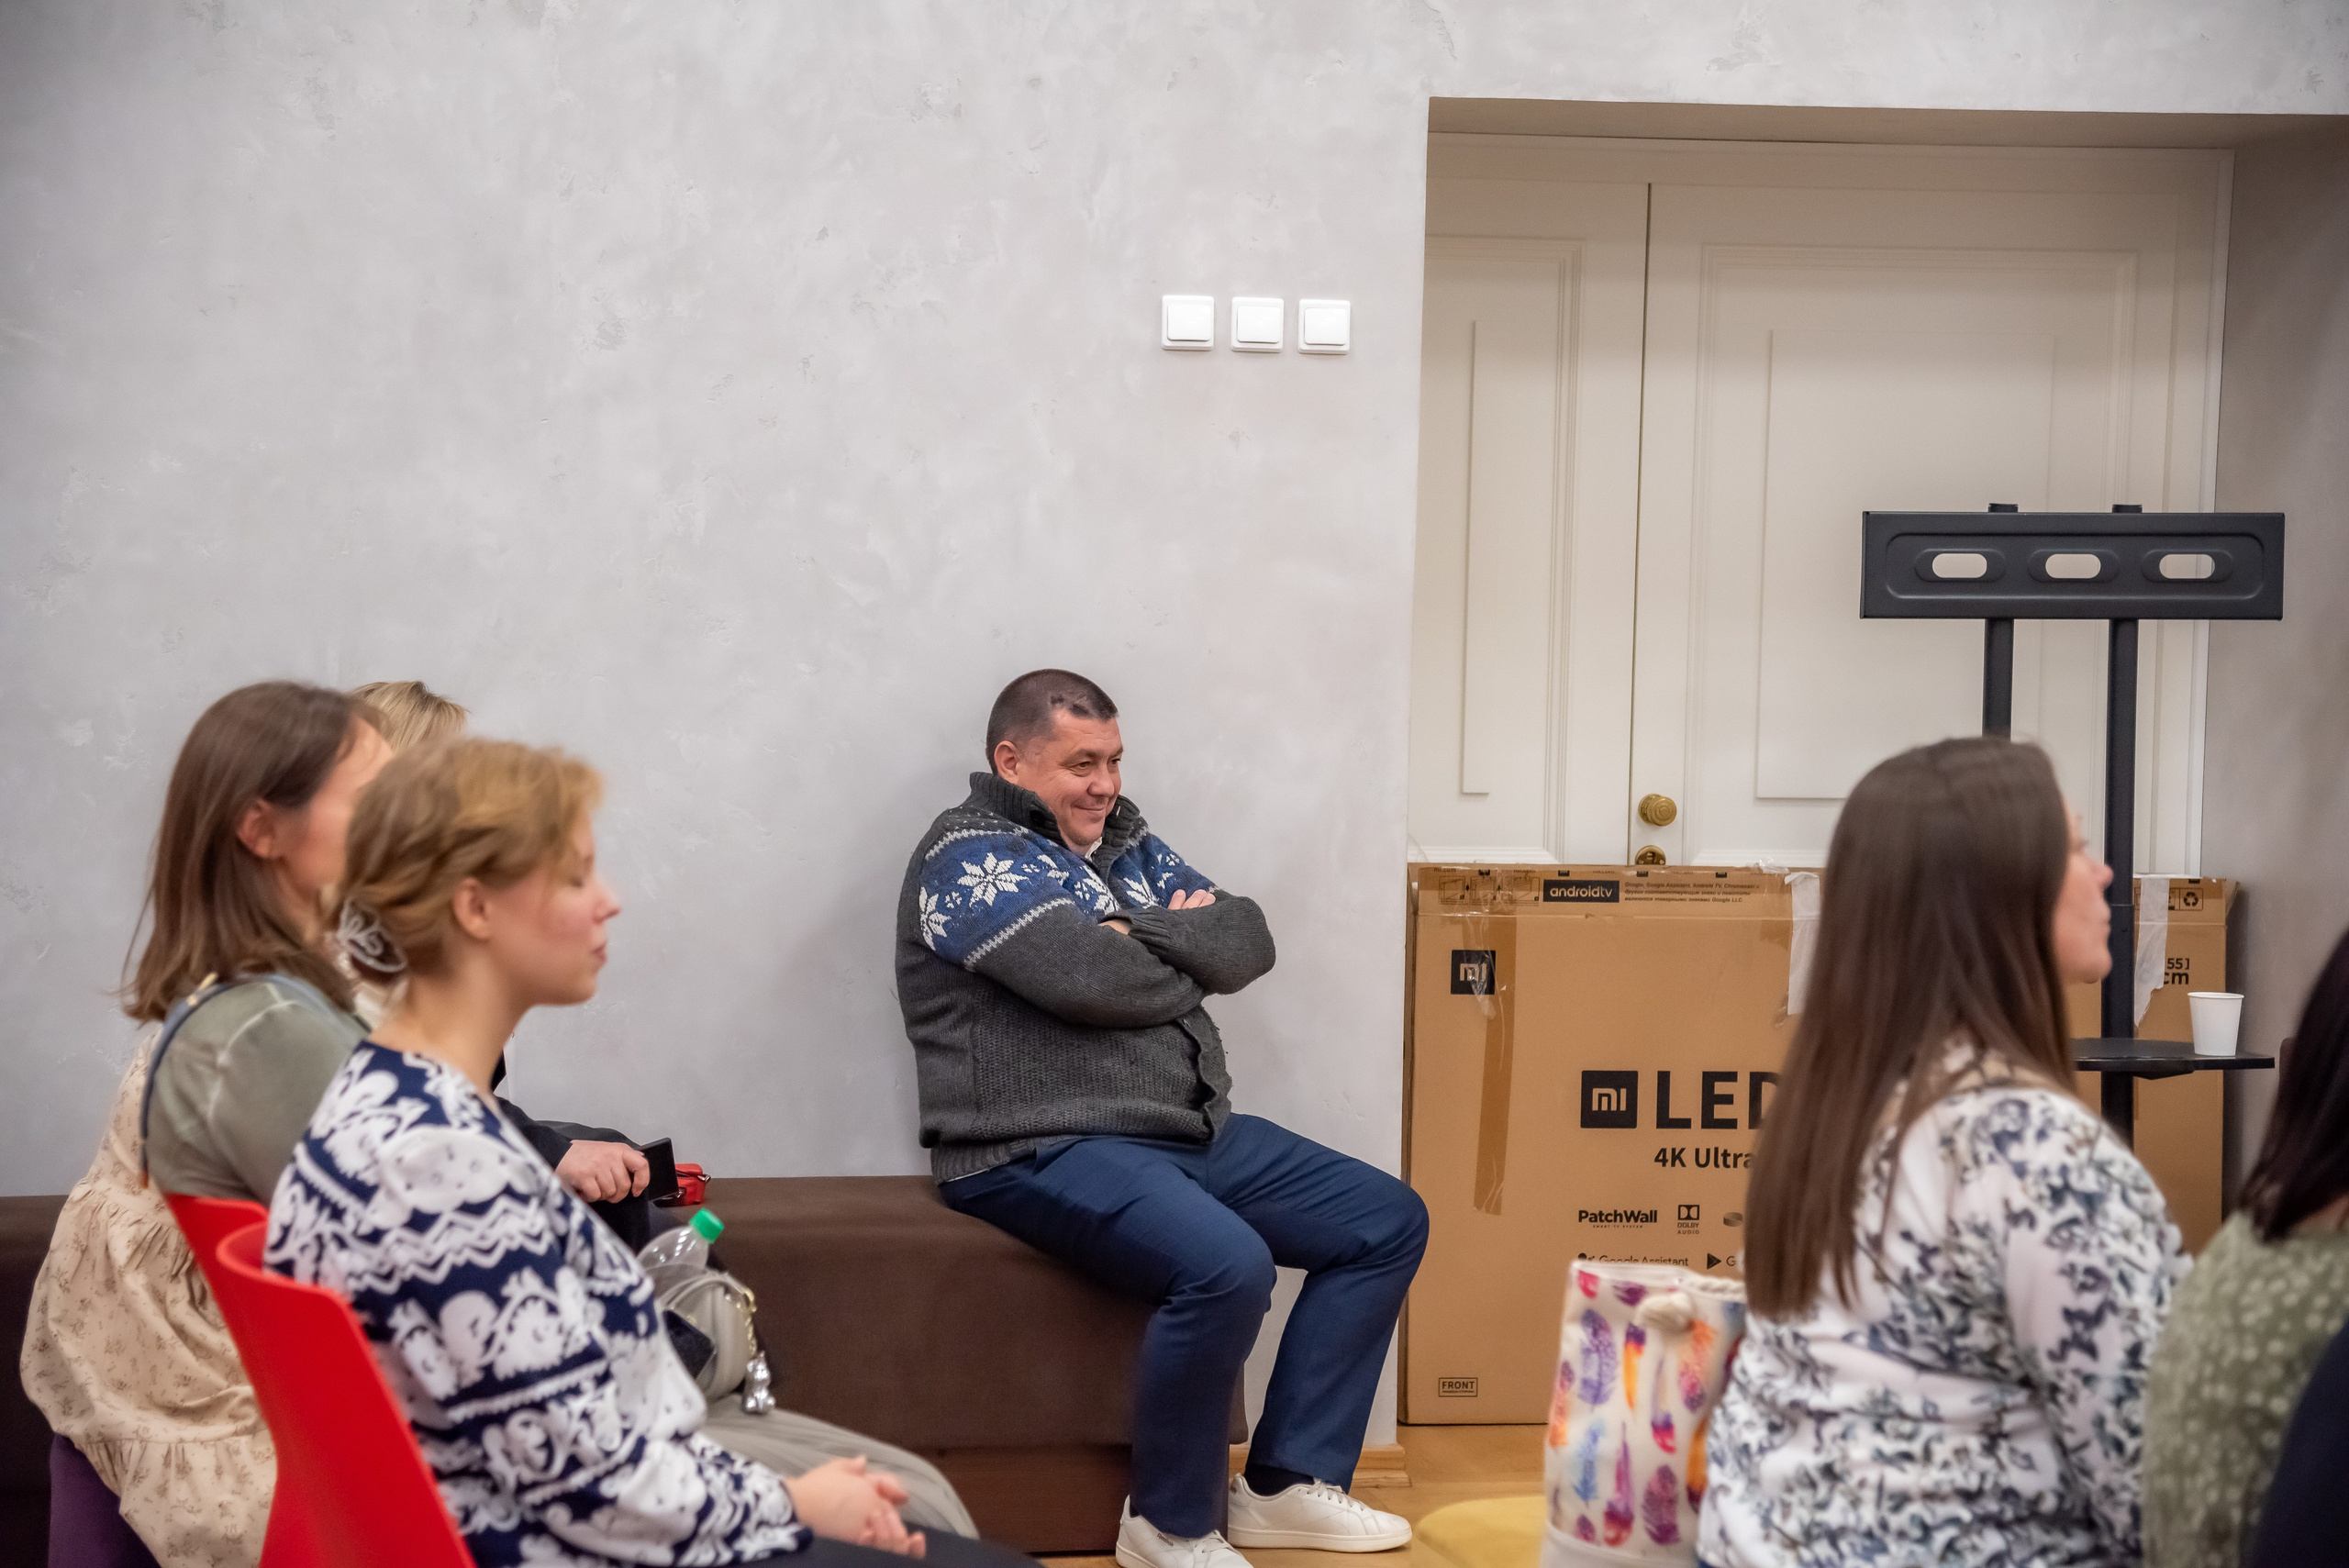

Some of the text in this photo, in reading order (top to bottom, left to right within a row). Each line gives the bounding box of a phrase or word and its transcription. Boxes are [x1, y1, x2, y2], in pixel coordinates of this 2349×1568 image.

[1654, 1148, 1687, 1168] 4K
[1578, 1209, 1658, 1223] PatchWall
[1442, 1381, 1475, 1389] FRONT
[1157, 1533, 1174, 1547] Reebok
